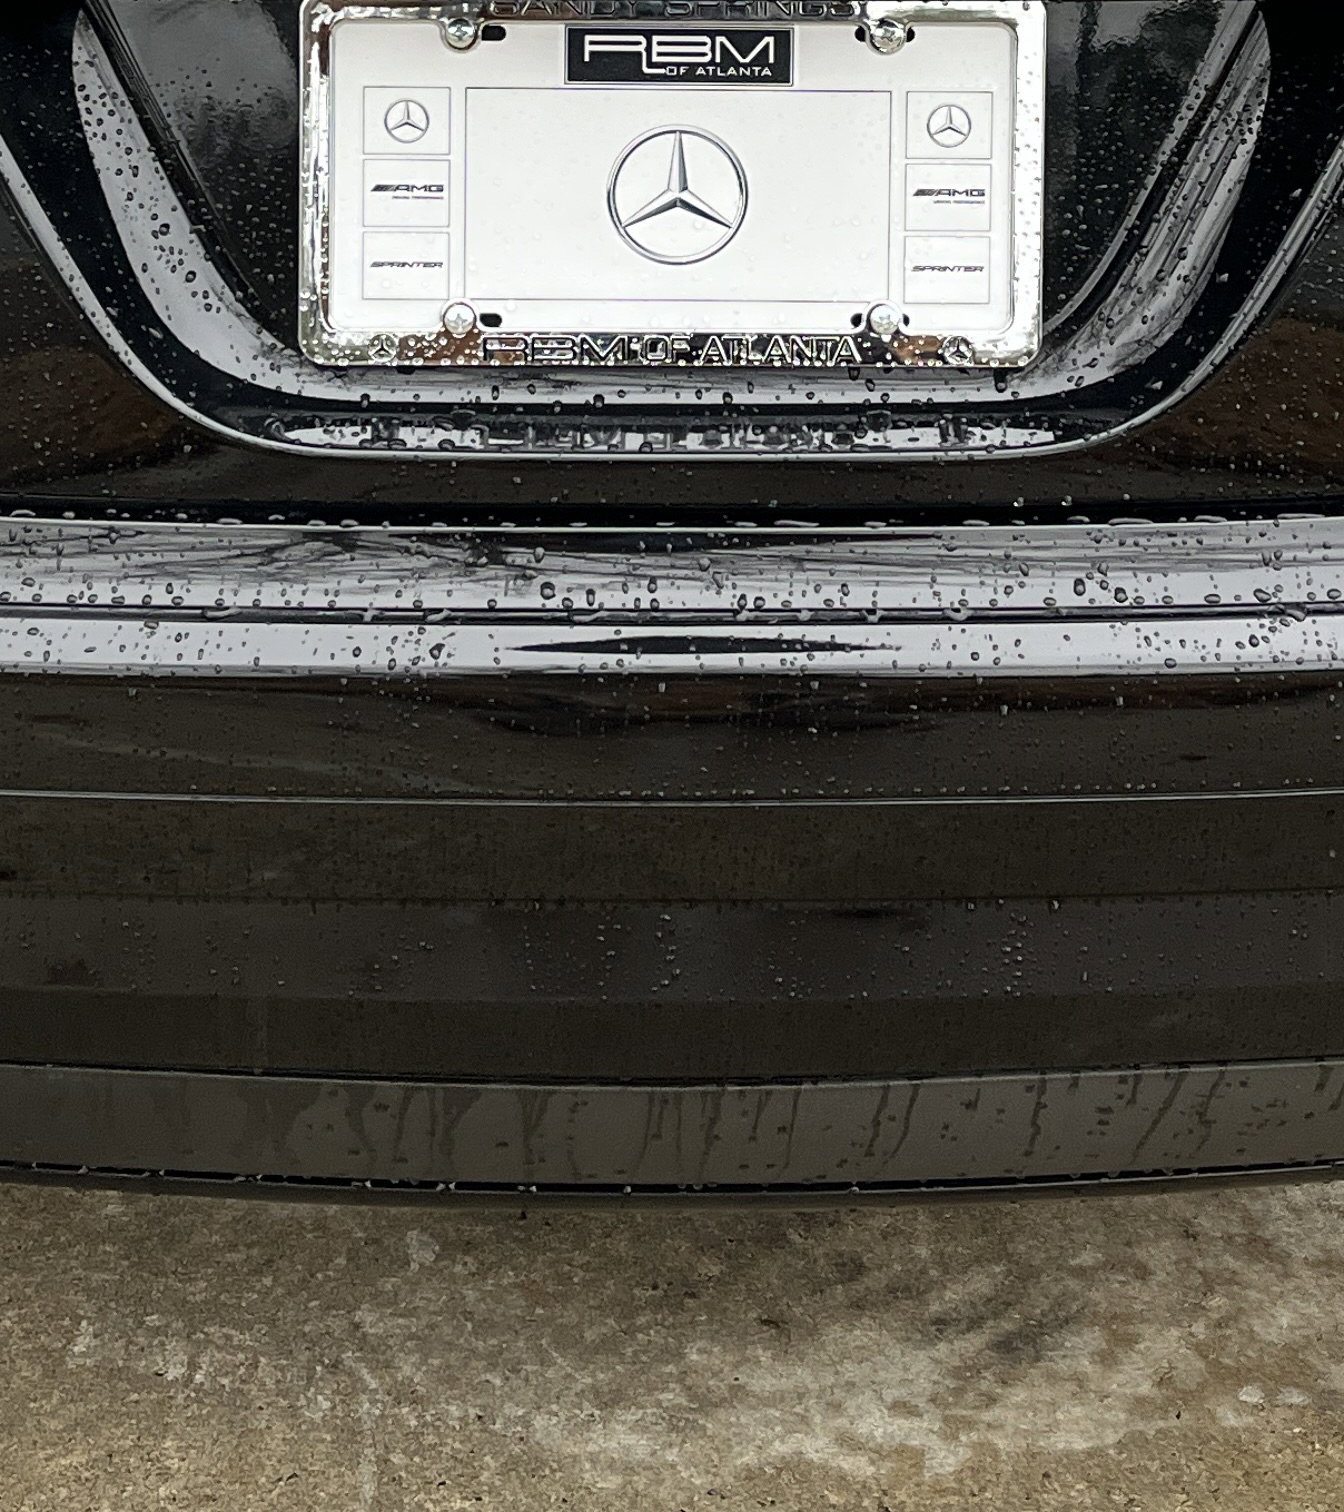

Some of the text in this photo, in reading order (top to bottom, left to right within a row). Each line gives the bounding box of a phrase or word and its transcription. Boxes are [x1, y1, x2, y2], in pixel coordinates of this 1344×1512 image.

[583, 34, 775, 74] RBM
[665, 66, 773, 77] OF ATLANTA
[394, 183, 444, 192] AMG
[936, 188, 986, 197] AMG
[482, 334, 862, 364] RBM OF ATLANTA
